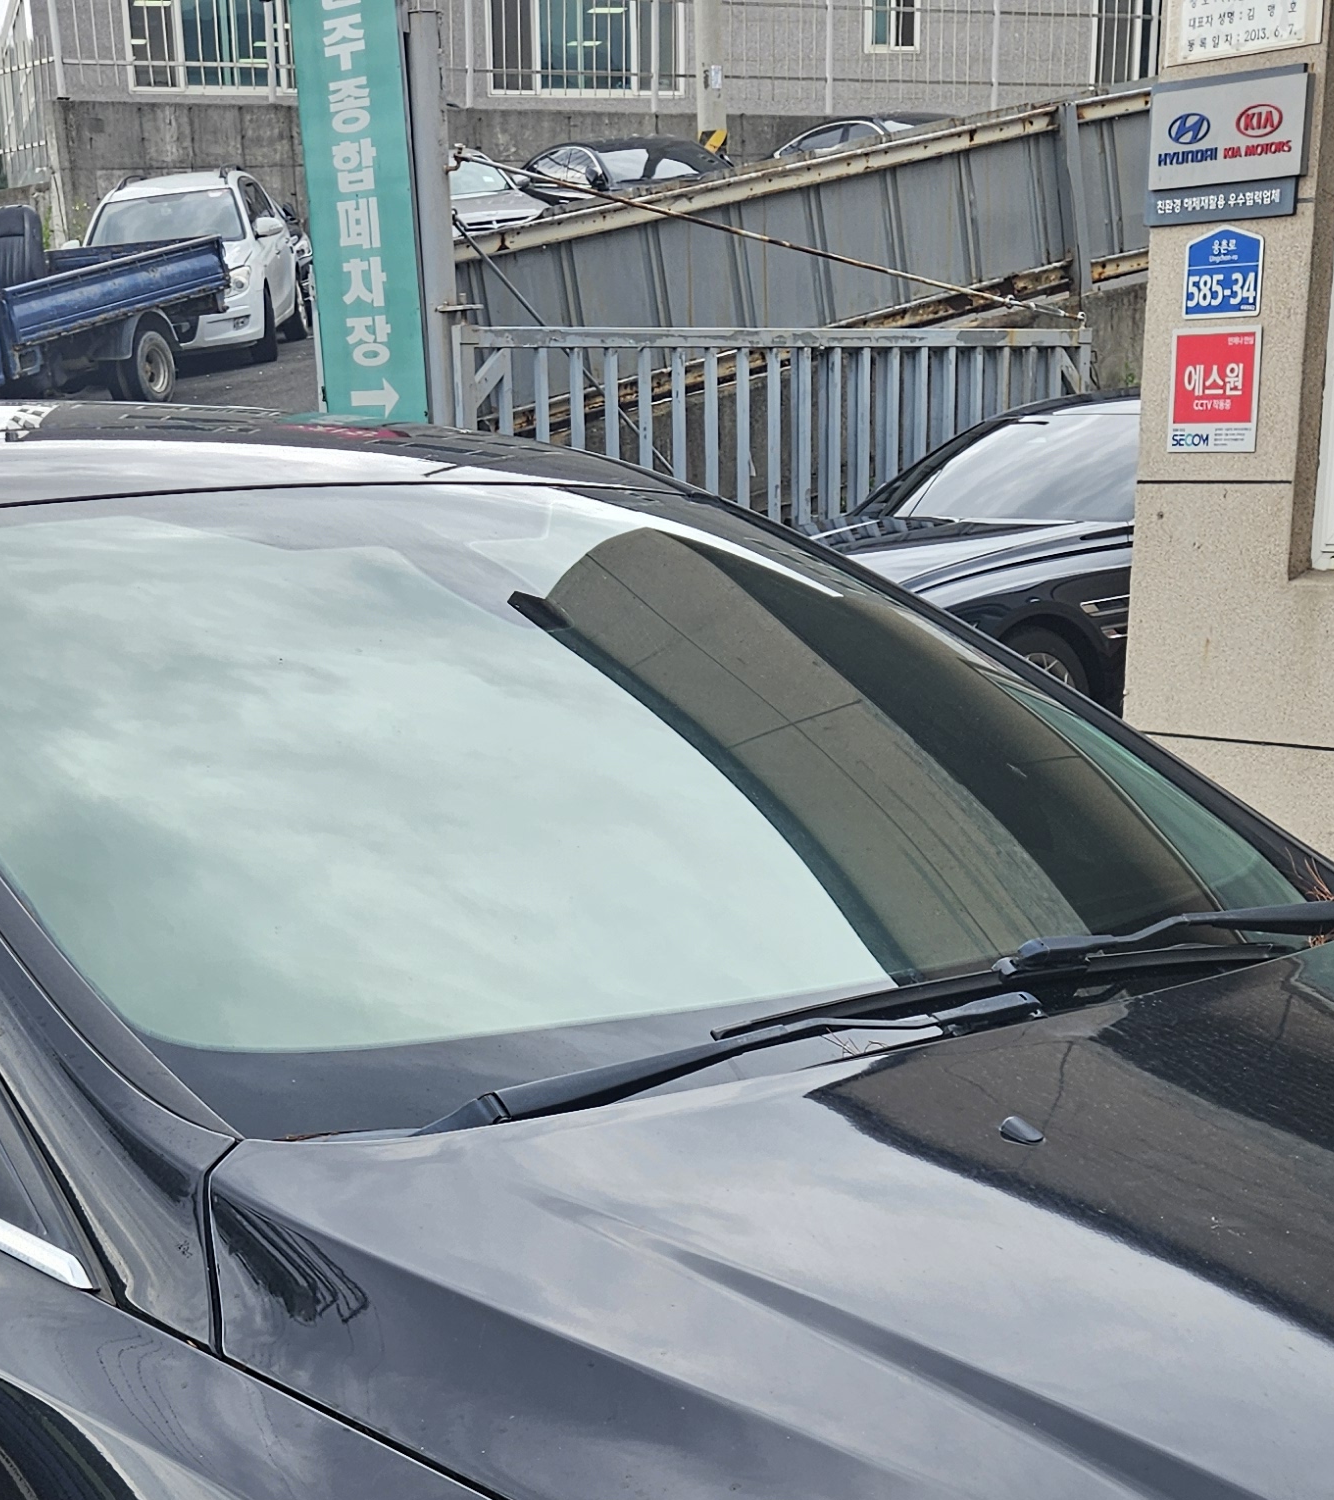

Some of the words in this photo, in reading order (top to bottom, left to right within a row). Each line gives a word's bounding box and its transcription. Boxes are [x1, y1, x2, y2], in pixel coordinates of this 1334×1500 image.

[1157, 147, 1218, 167] HYUNDAI
[1223, 146, 1243, 160] KIA
[1244, 140, 1292, 157] MOTORS
[1156, 199, 1182, 214] 친환경
[1186, 271, 1256, 308] 585-34
[1183, 362, 1244, 397] 에스원
[1193, 399, 1213, 411] CCTV
[1171, 432, 1210, 448] SECOM
